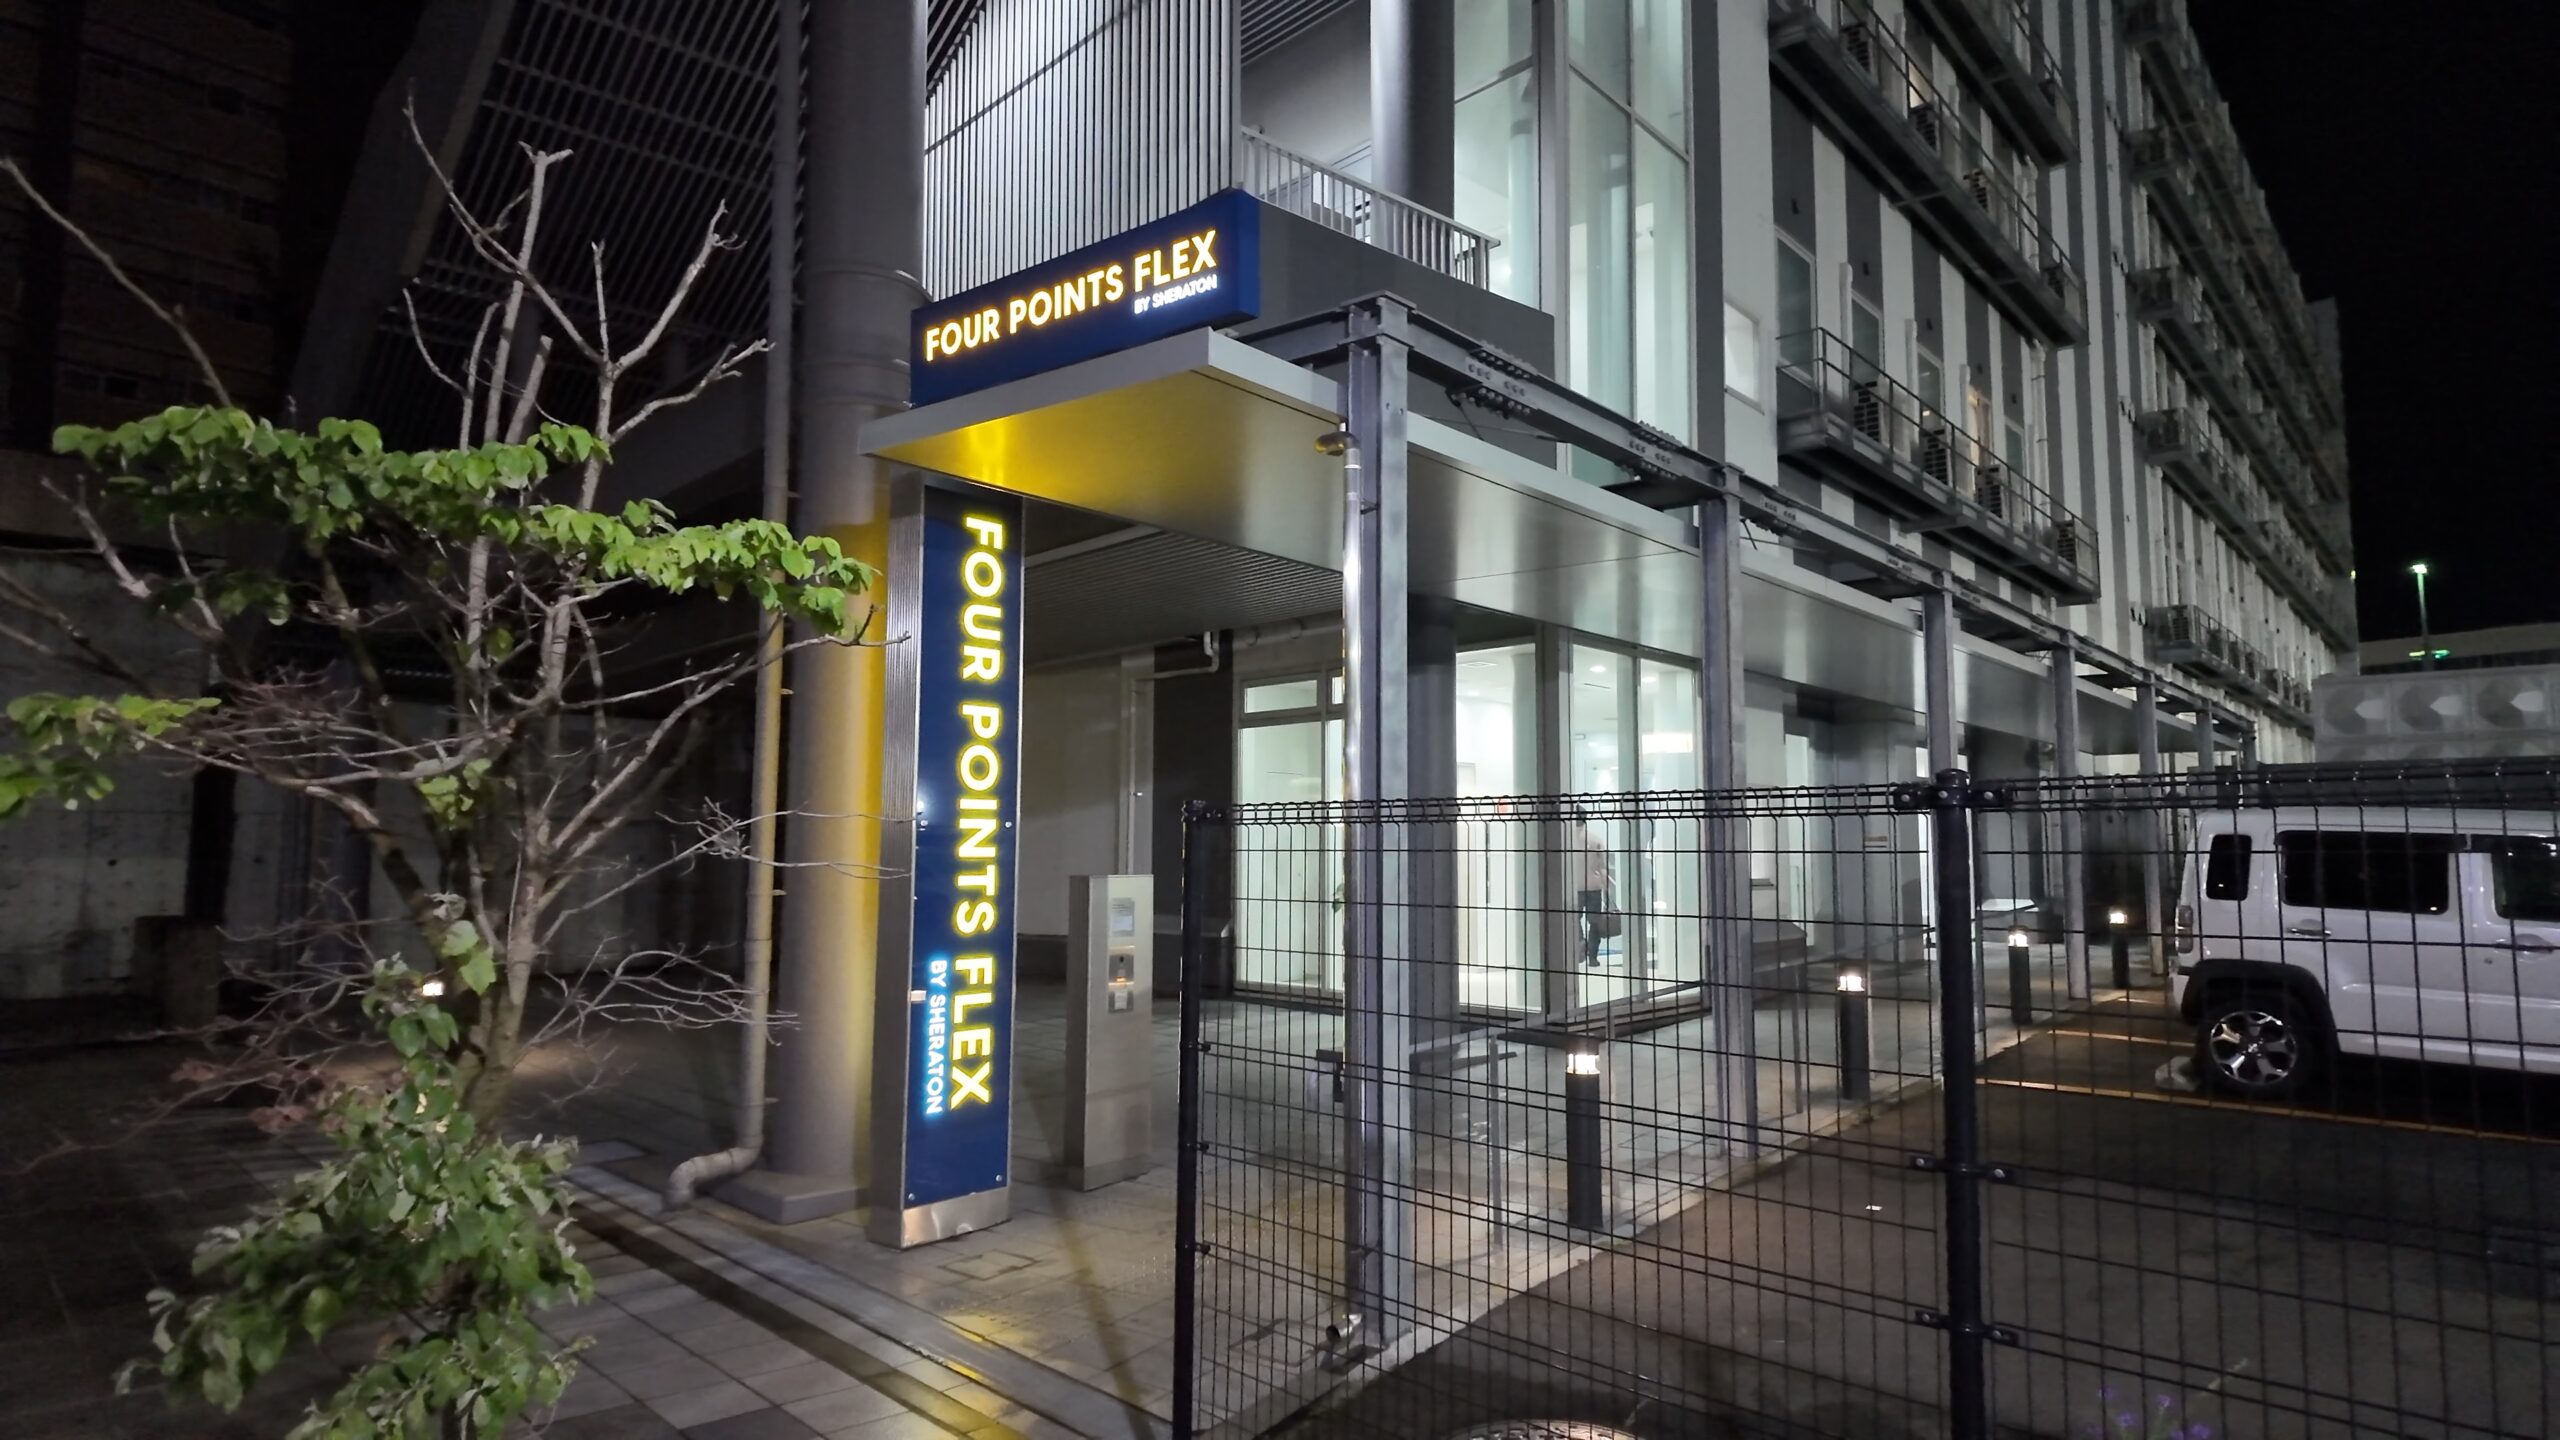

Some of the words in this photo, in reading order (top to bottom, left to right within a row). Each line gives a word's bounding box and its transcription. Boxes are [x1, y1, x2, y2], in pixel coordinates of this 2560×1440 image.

[926, 308, 1000, 362] FOUR
[1009, 264, 1124, 334] POINTS
[1134, 230, 1217, 292] FLEX
[1134, 296, 1151, 315] BY
[1152, 273, 1218, 308] SHERATON
[962, 516, 1004, 680] FOUR
[955, 703, 1000, 934] POINTS
[930, 959, 948, 988] BY
[950, 957, 994, 1110] FLEX
[926, 994, 946, 1115] SHERATON
